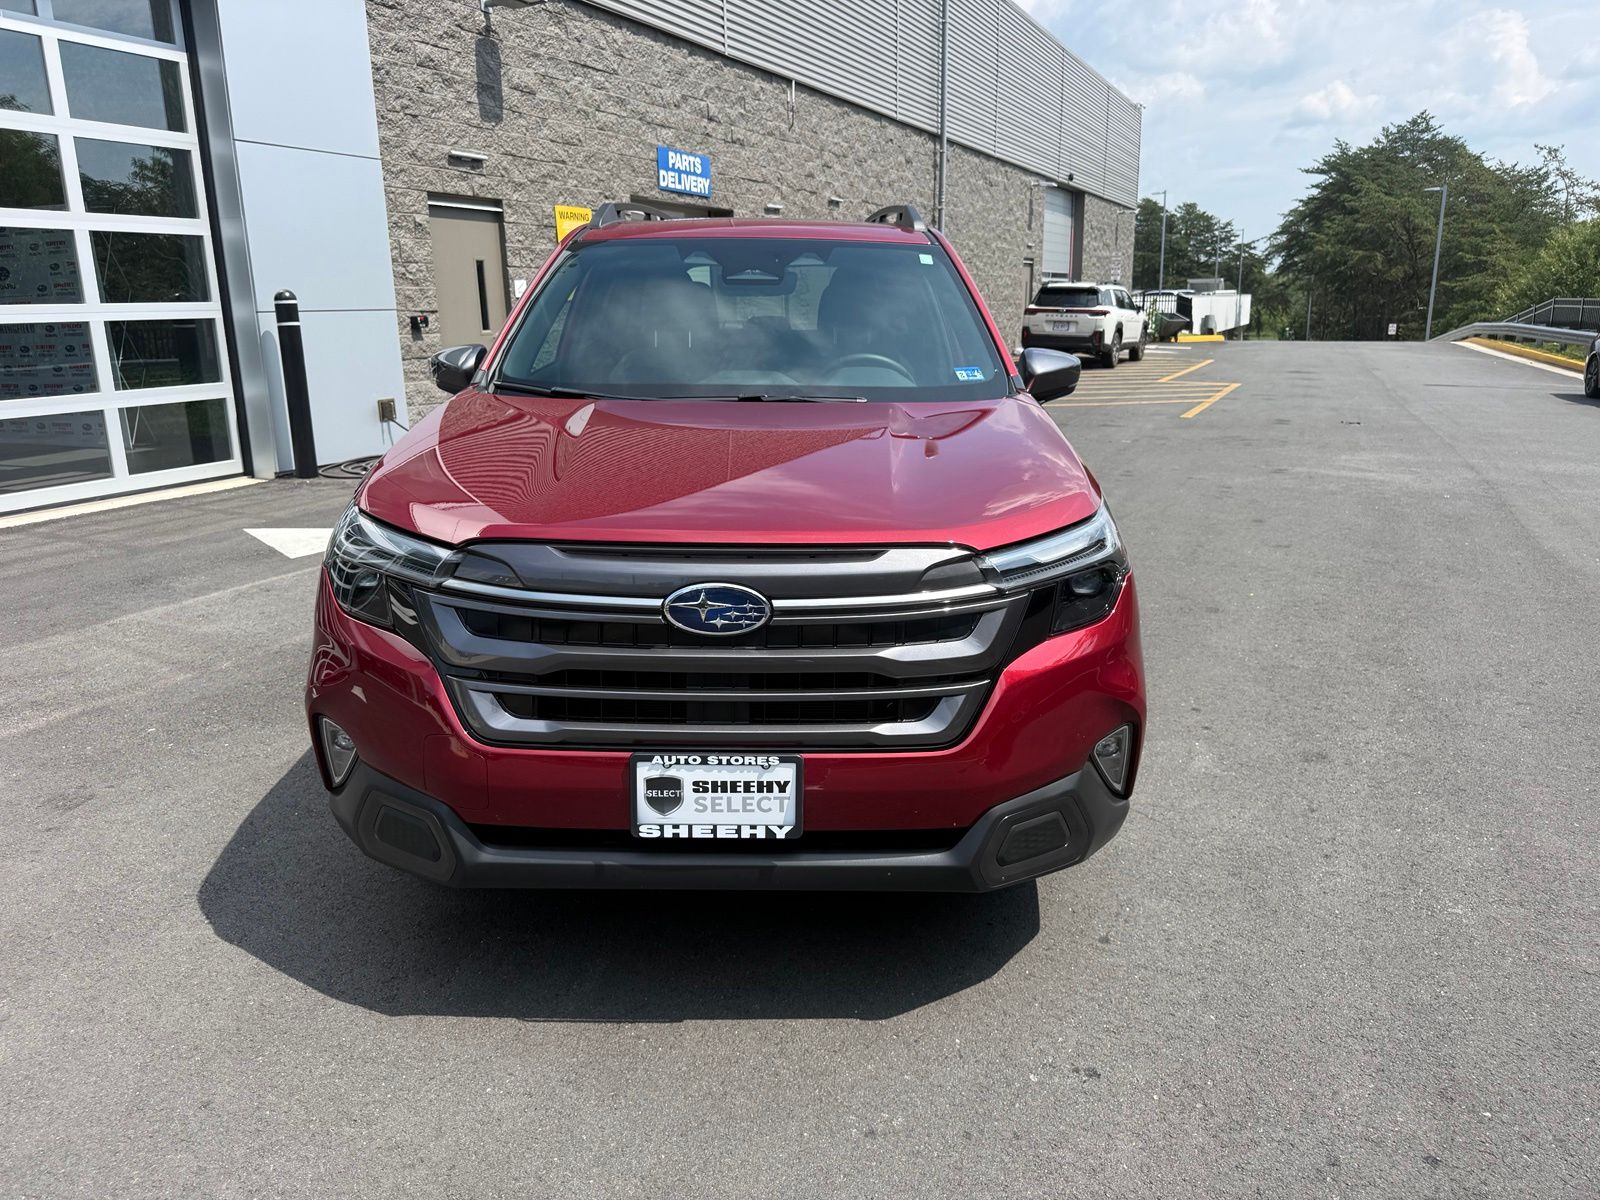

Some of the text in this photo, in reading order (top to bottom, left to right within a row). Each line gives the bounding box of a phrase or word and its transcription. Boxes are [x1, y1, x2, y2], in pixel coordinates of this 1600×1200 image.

[668, 151, 702, 174] PARTS
[659, 169, 710, 195] DELIVERY
[558, 211, 590, 222] WARNING
[651, 756, 780, 766] AUTO STORES
[646, 789, 681, 798] SELECT
[692, 780, 791, 794] SHEEHY
[694, 796, 791, 813] SELECT
[638, 824, 794, 839] SHEEHY
